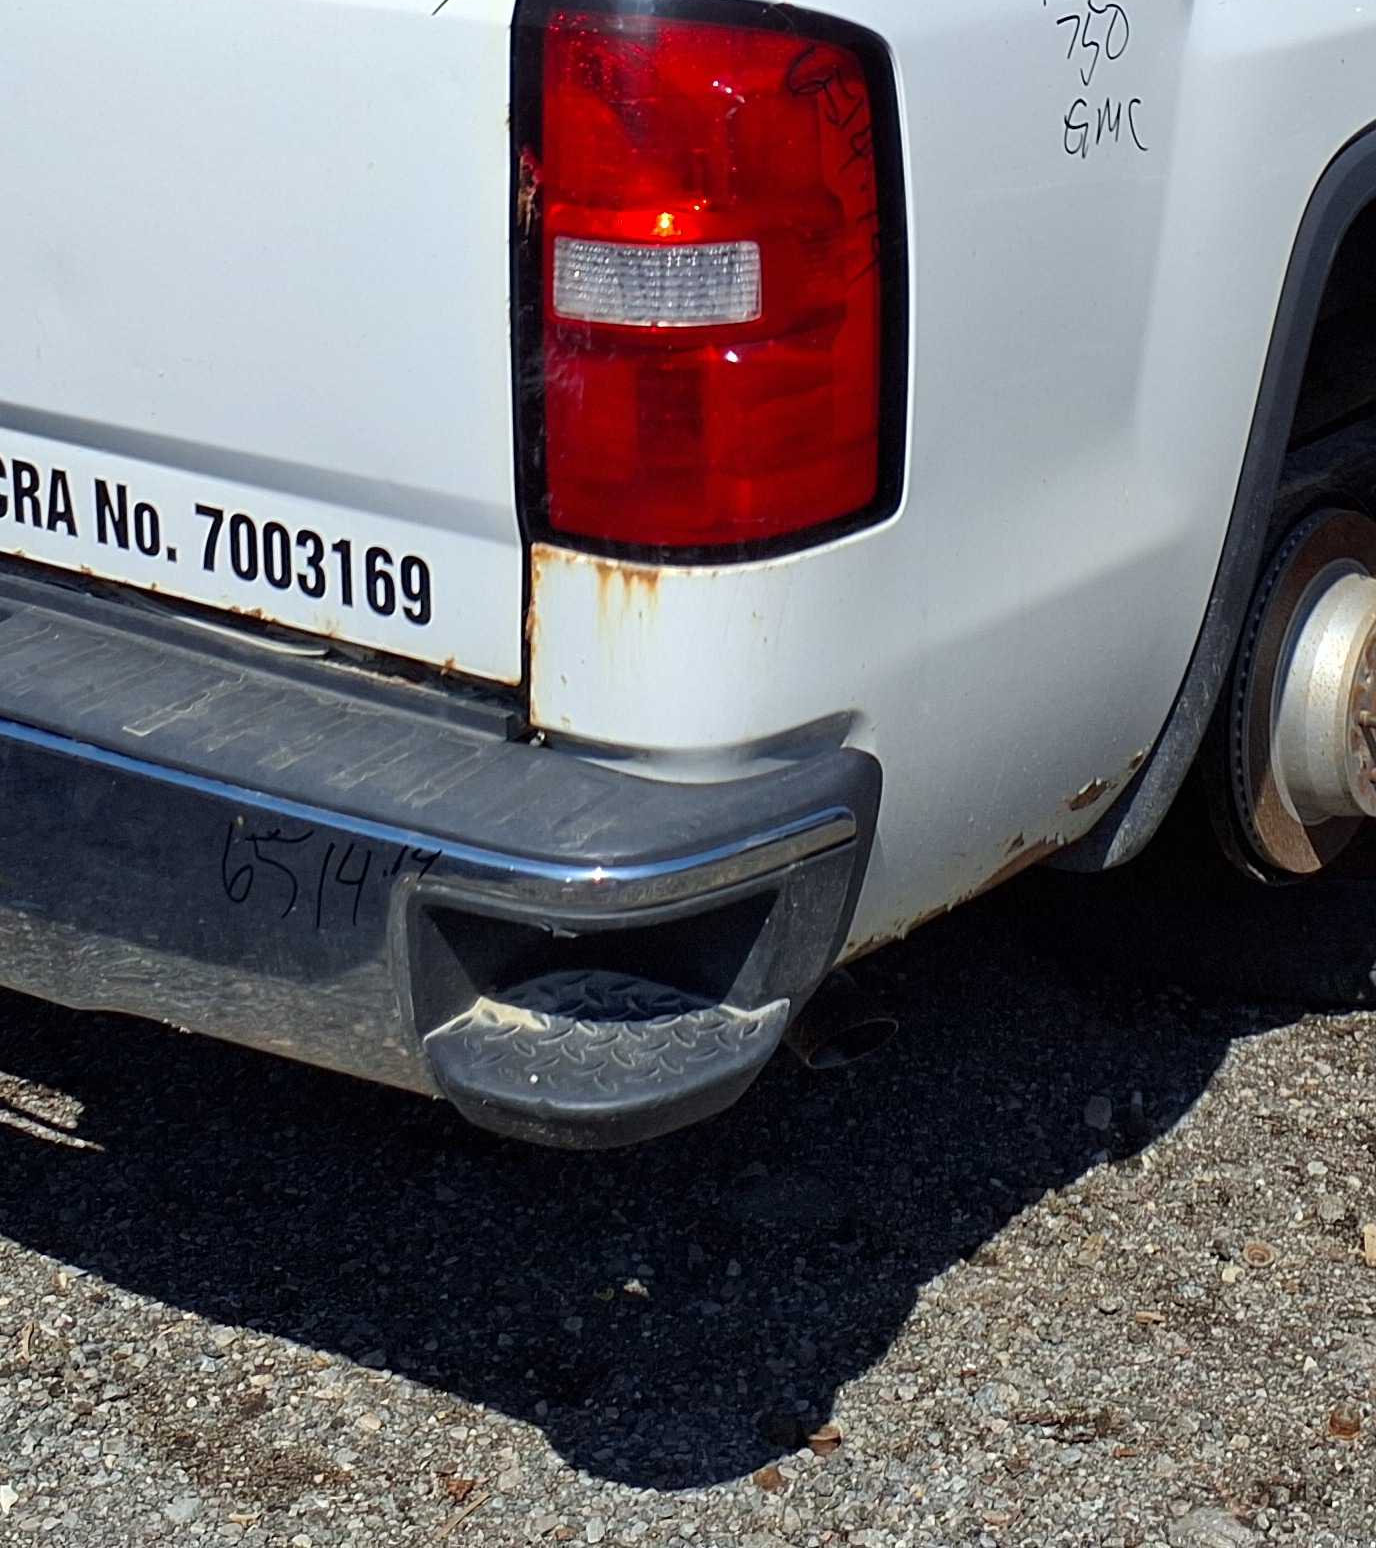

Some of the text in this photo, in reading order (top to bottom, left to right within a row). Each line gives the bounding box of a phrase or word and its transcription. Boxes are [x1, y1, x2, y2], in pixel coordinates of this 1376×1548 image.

[1062, 97, 1150, 159] GMC
[94, 478, 179, 564] No.
[194, 503, 434, 627] 7003169
